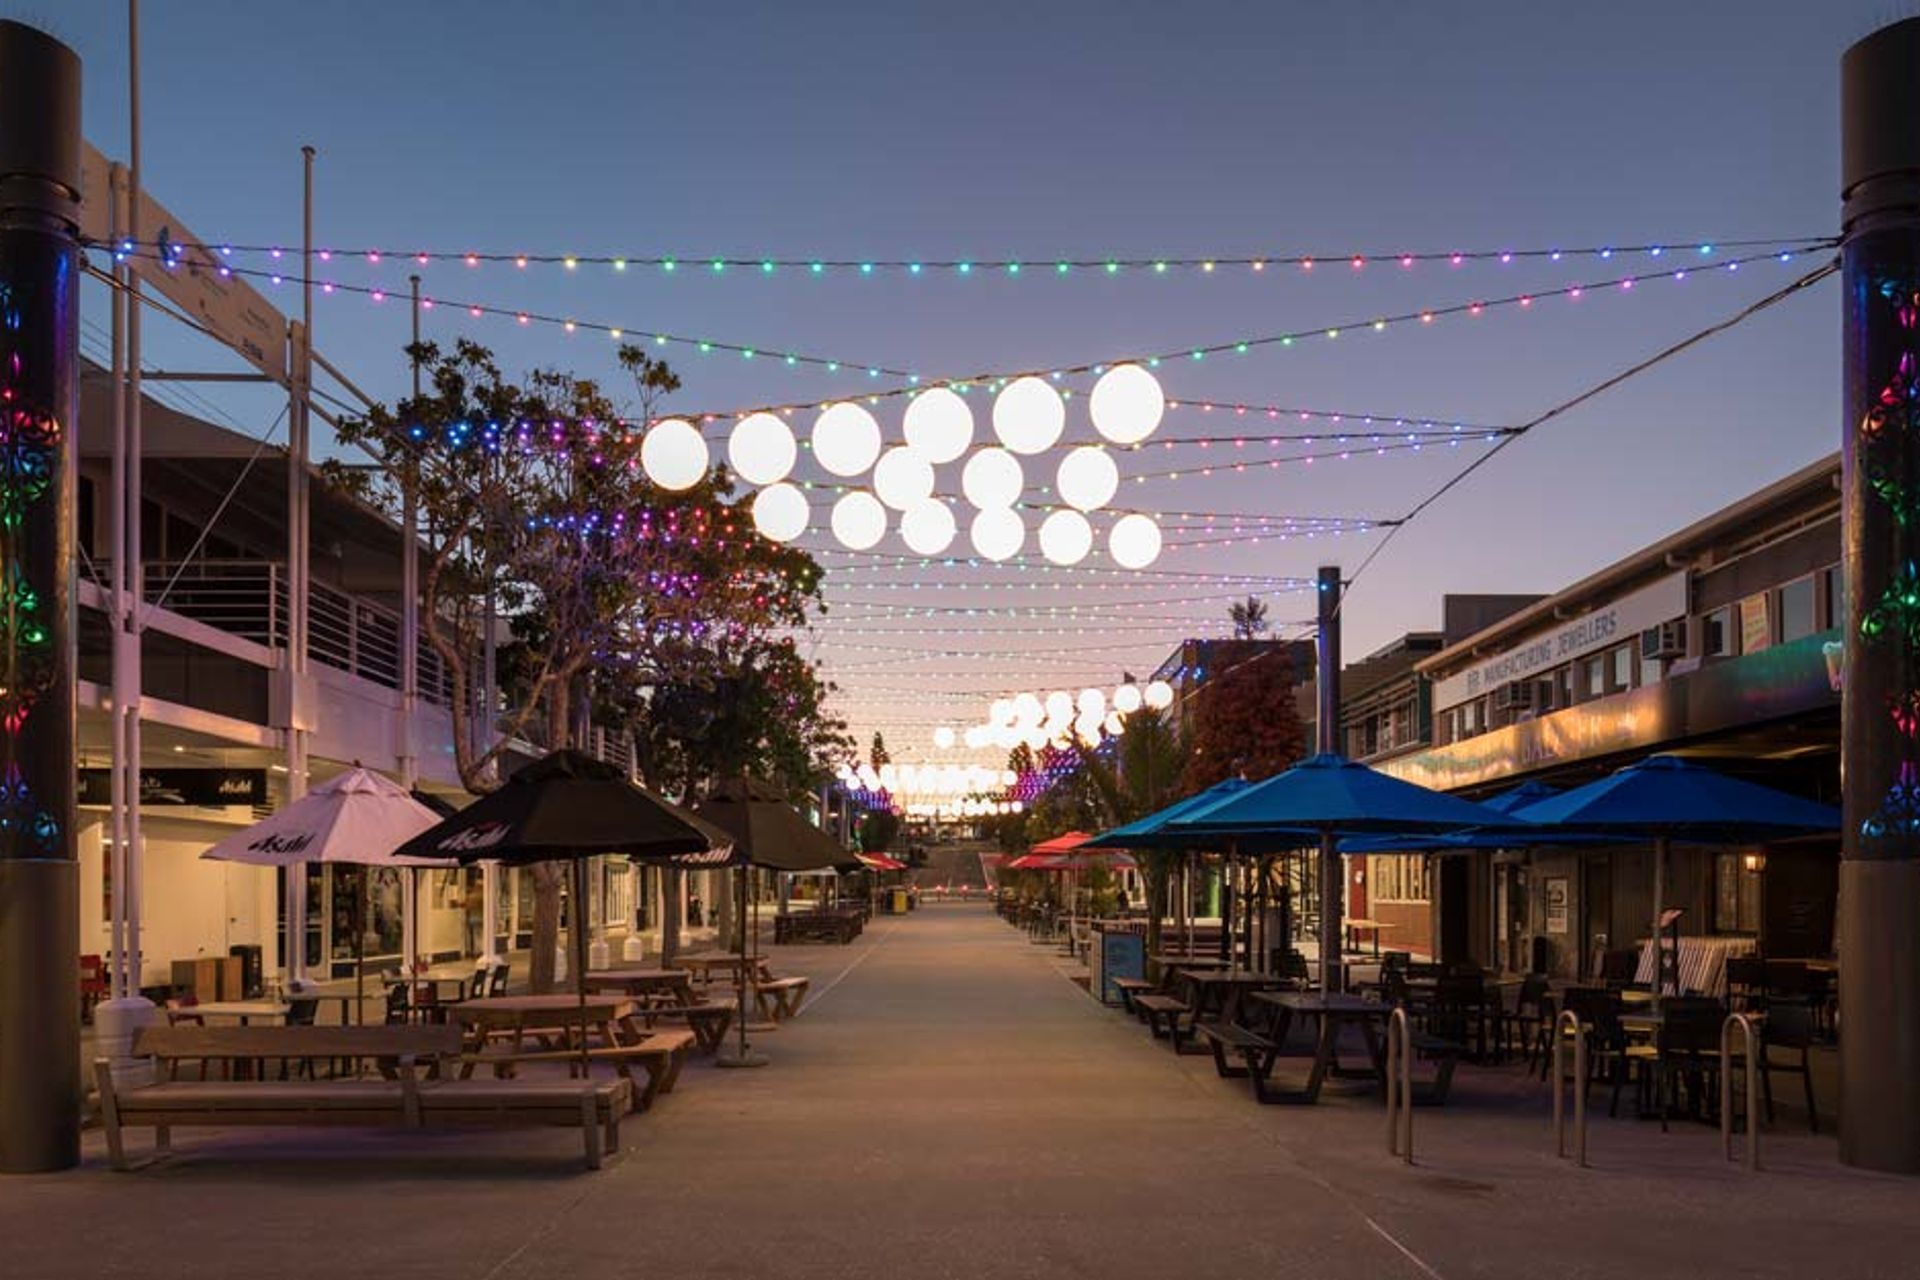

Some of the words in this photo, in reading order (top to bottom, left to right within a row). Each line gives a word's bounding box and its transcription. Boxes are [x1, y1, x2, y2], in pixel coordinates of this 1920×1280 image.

[1484, 640, 1551, 685] MANUFACTURING
[1558, 611, 1617, 656] JEWELLERS
[248, 833, 315, 853] Asahi
[436, 823, 511, 851] Asahi
